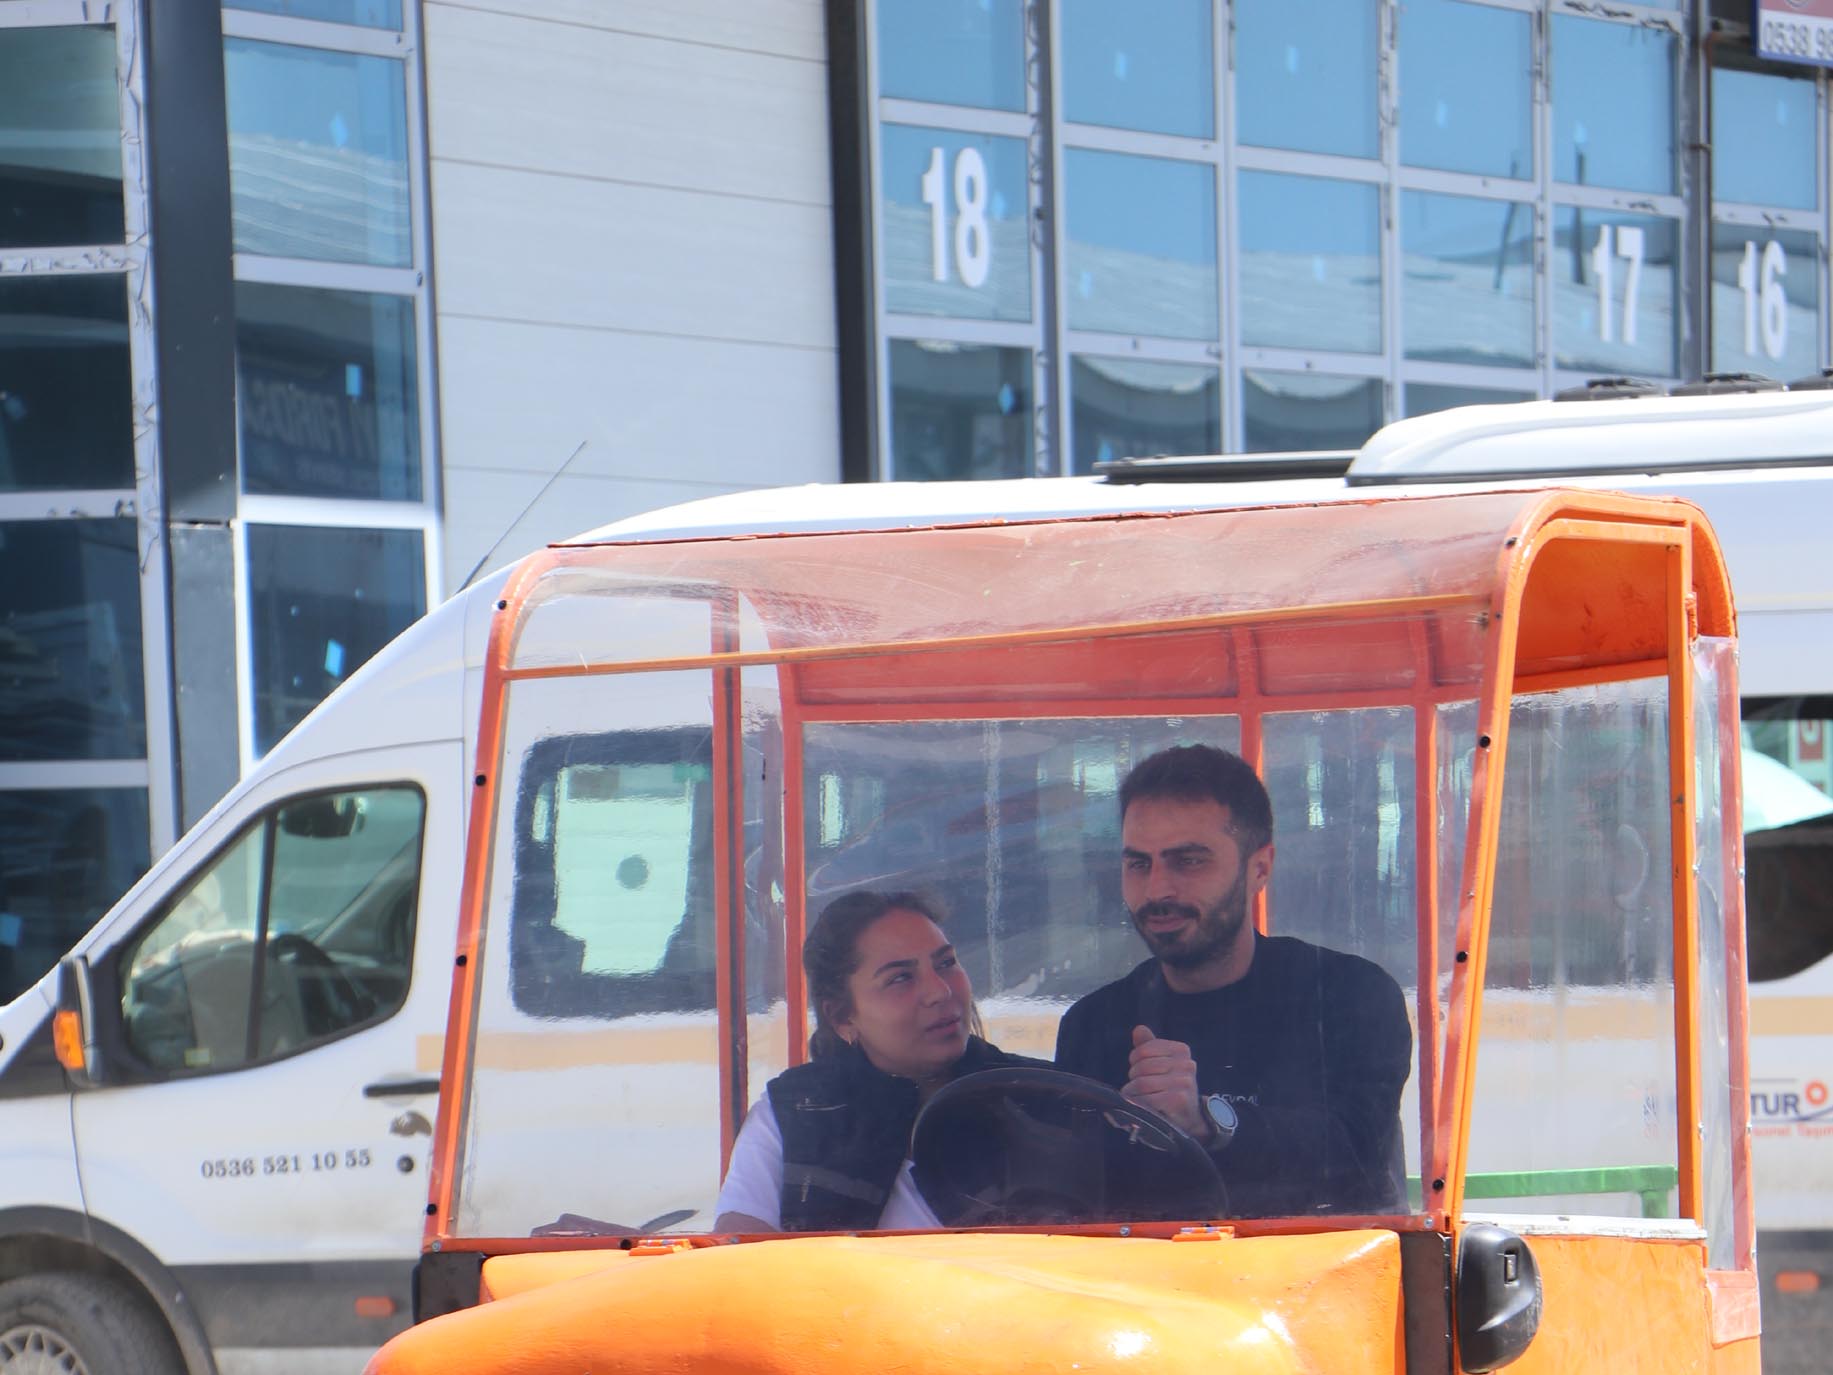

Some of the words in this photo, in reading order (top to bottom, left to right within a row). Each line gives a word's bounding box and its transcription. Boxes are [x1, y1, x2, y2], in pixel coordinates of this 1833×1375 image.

[922, 147, 990, 287] 18
[1593, 224, 1644, 344] 17
[1738, 240, 1787, 358] 16
[200, 1157, 255, 1179] 0536
[263, 1155, 301, 1175] 521
[312, 1152, 337, 1171] 10
[345, 1149, 371, 1168] 55
